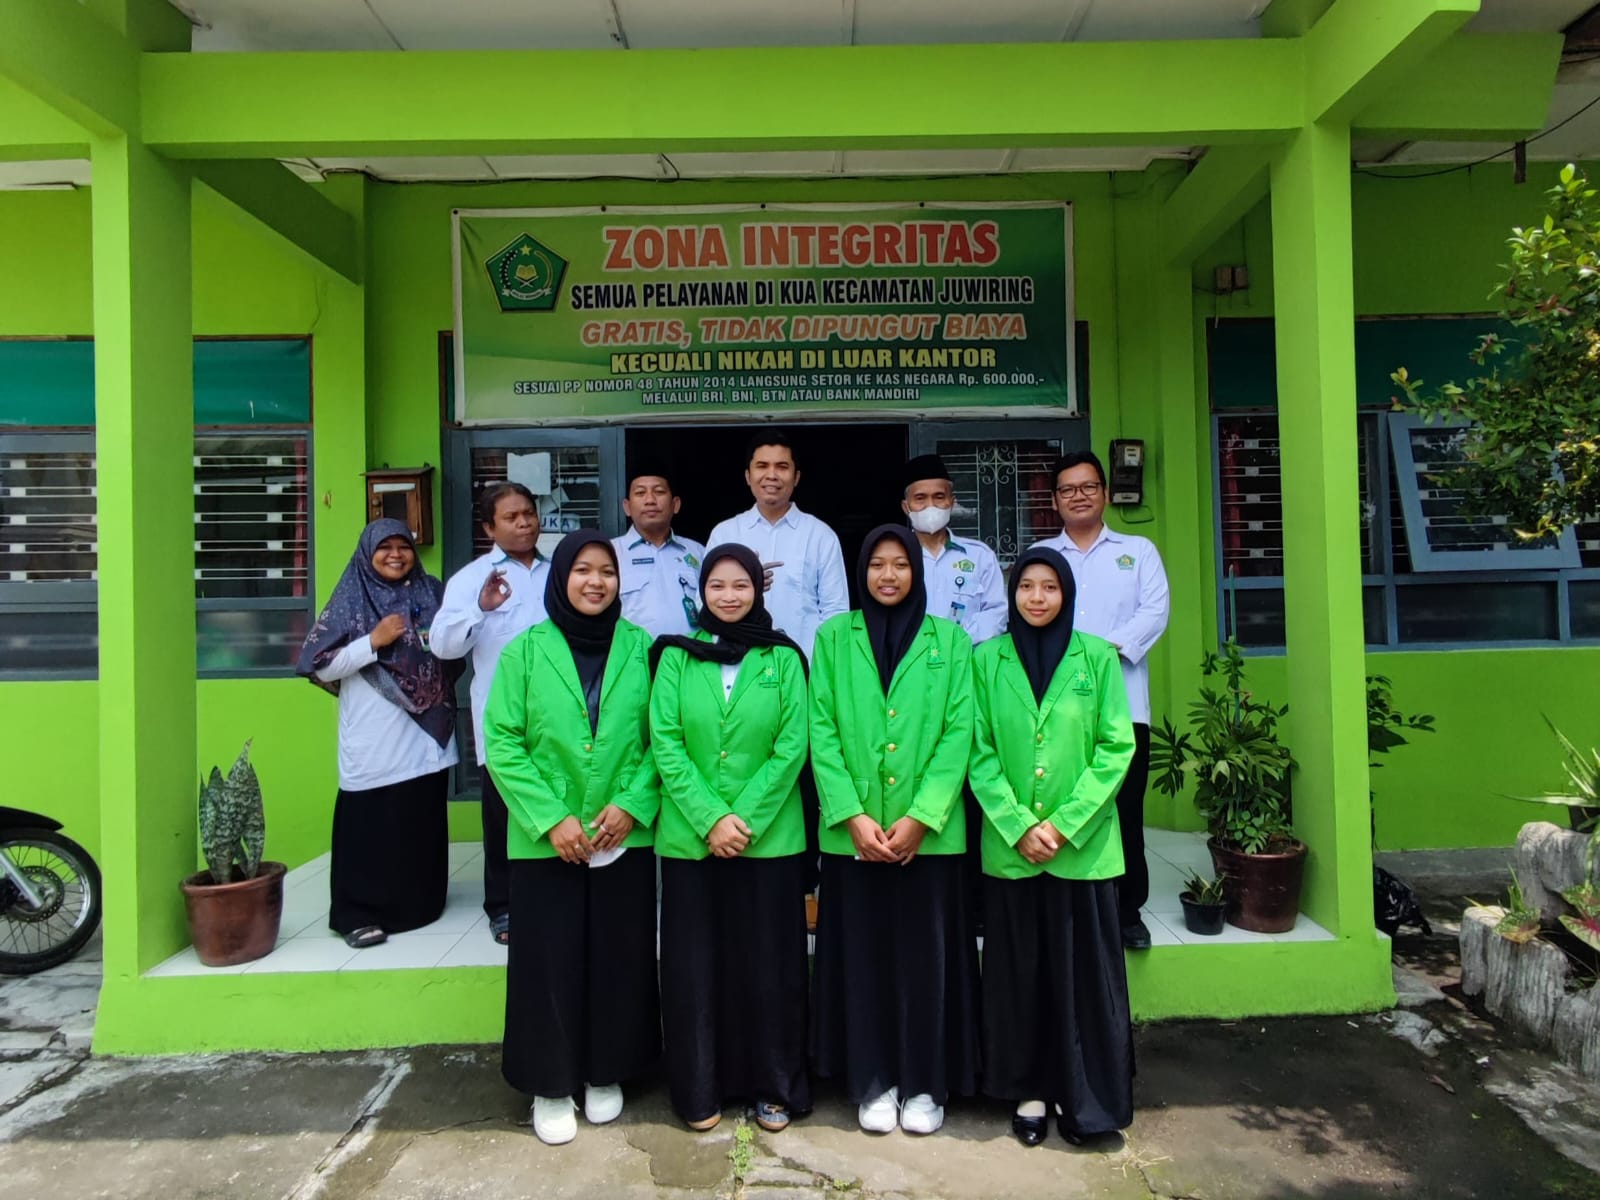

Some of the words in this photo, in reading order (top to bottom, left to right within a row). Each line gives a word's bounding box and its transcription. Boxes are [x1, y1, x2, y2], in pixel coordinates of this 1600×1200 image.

[604, 227, 729, 270] ZONA
[743, 223, 999, 267] INTEGRITAS
[571, 283, 637, 310] SEMUA
[643, 281, 748, 307] PELAYANAN
[755, 280, 773, 305] DI
[780, 279, 817, 305] KUA
[823, 278, 934, 304] KECAMATAN
[940, 277, 1033, 303] JUWIRING
[582, 319, 690, 347] GRATIS,
[700, 318, 785, 342] TIDAK
[791, 315, 938, 341] DIPUNGUT
[944, 314, 1026, 340] BIAYA
[611, 352, 711, 374] KECUALI
[718, 350, 793, 371] NIKAH
[800, 349, 825, 369] DI
[832, 349, 893, 369] LUAR
[899, 348, 996, 368] KANTOR
[514, 381, 560, 394] SESUAI
[564, 380, 581, 393] PP
[585, 378, 633, 392] NOMOR
[637, 377, 654, 390] 48
[658, 376, 700, 389] TAHUN
[704, 376, 736, 388] 2014
[740, 375, 807, 388] LANGSUNG
[811, 374, 852, 386] SETOR
[856, 374, 872, 386] KE
[876, 373, 900, 385] KAS
[904, 373, 955, 385] NEGARA
[959, 373, 979, 387] Rp.
[983, 373, 1045, 387] 600.000,-
[642, 391, 697, 405] MELALUI
[702, 390, 728, 403] BRI,
[732, 390, 758, 403] BNI,
[762, 390, 786, 402] BTN
[790, 389, 822, 401] ATAU
[826, 388, 860, 400] BANK
[864, 387, 920, 400] MANDIRI
